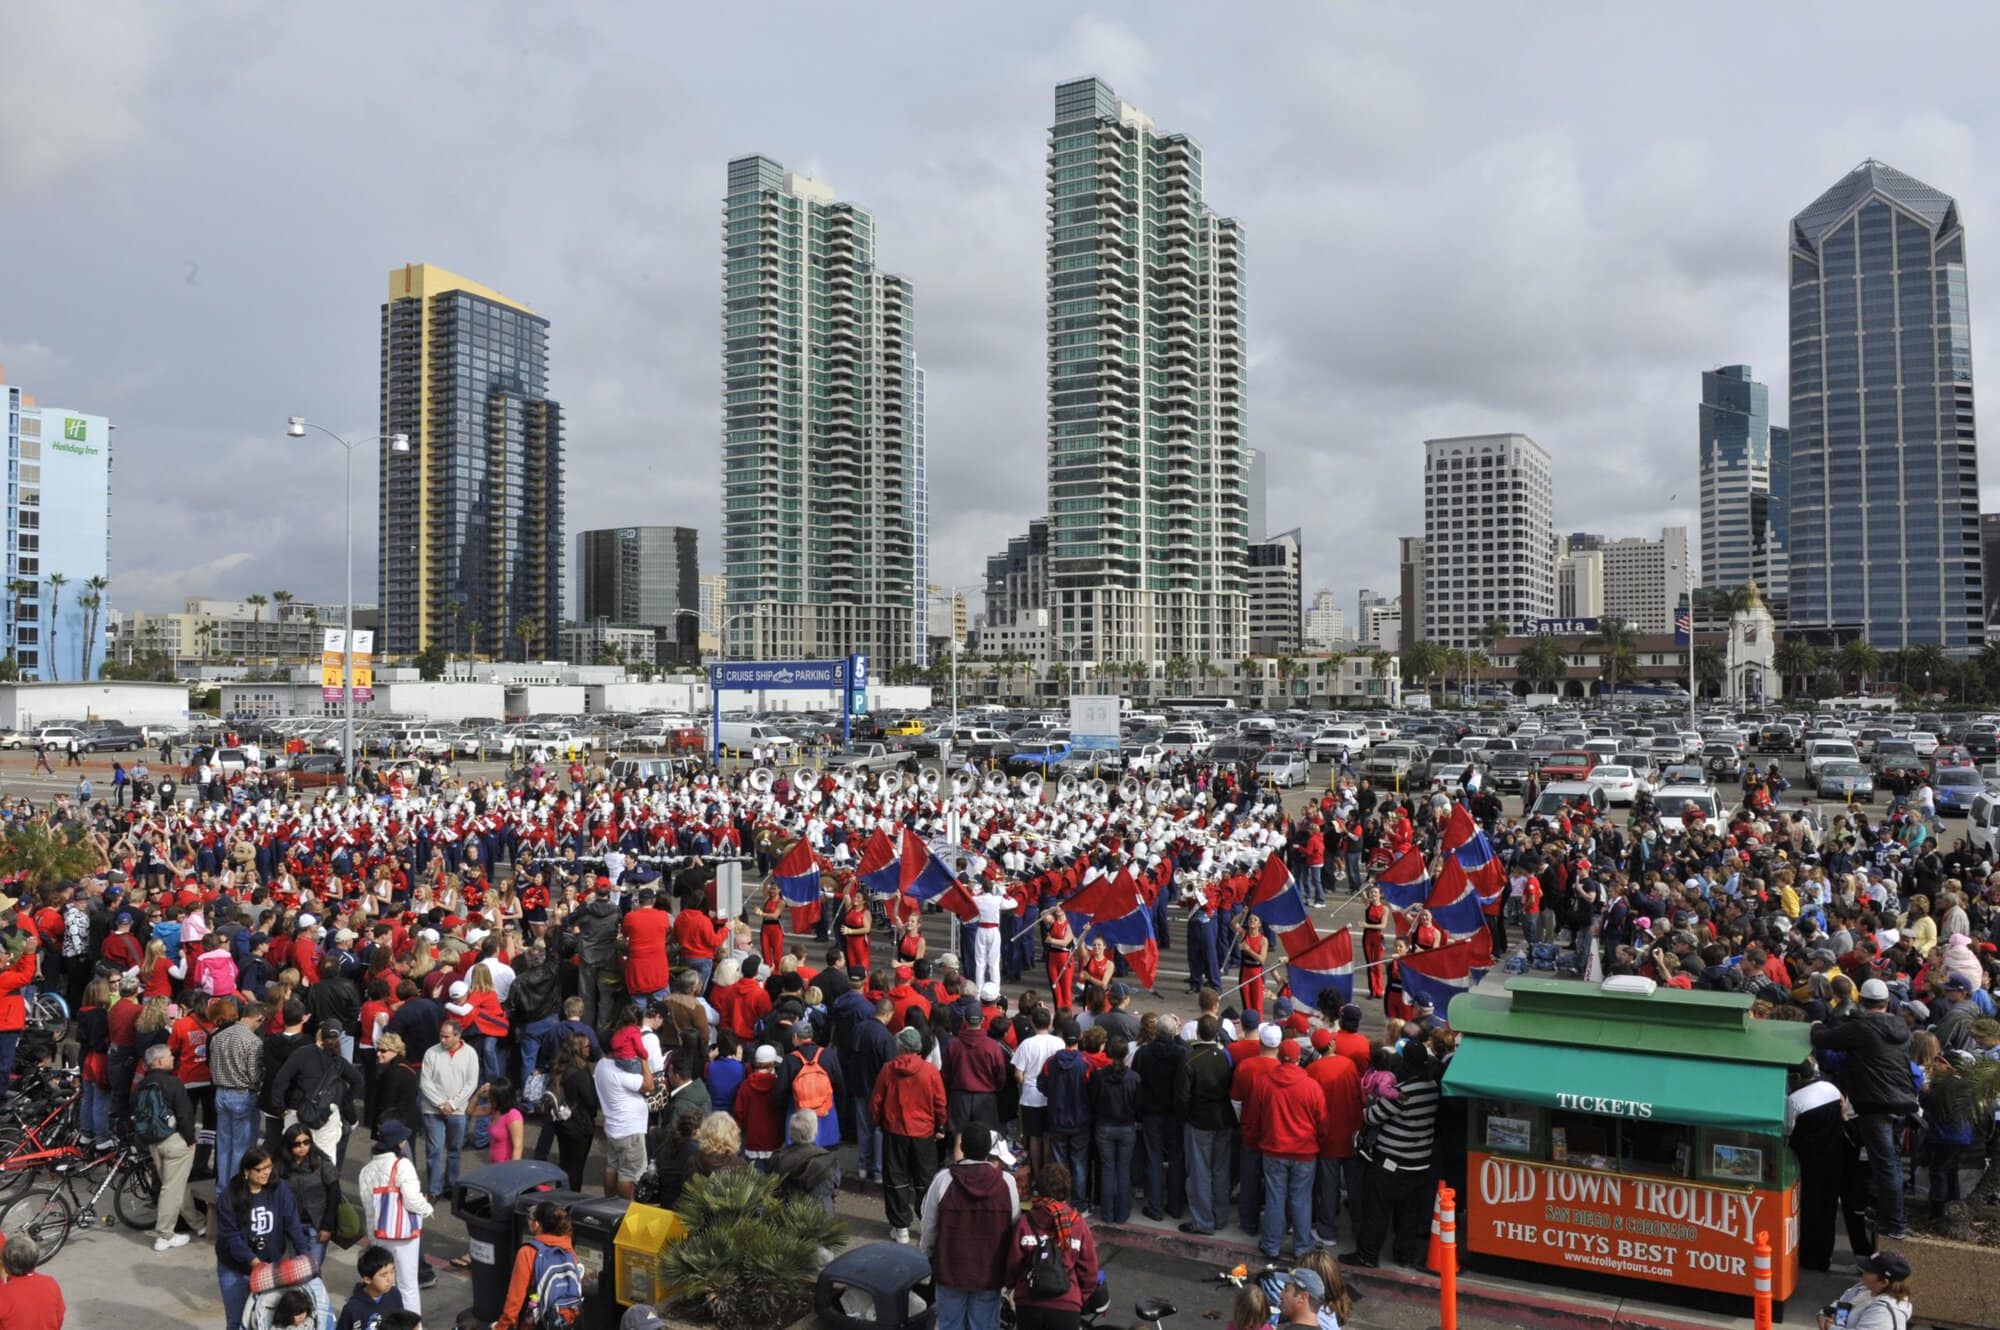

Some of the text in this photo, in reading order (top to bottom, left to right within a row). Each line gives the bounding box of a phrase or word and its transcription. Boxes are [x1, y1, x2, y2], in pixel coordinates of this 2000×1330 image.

[52, 441, 98, 455] Holiday Inn
[1526, 619, 1586, 633] Santa
[716, 667, 723, 679] 5
[727, 669, 831, 681] CRUISE SHIP PARKING
[835, 665, 842, 678] 5
[855, 656, 864, 678] 5
[856, 694, 864, 710] P
[1556, 1092, 1653, 1118] TICKETS
[1480, 1159, 1537, 1205] OLD
[1541, 1168, 1622, 1206] TOWN
[1632, 1179, 1765, 1245] TROLLEY
[251, 1206, 274, 1236] SD
[1545, 1205, 1698, 1242] SAN DIEGO & CORONADO
[1493, 1220, 1747, 1277] THE CITY'S BEST TOUR
[1564, 1252, 1673, 1277] www.trolleytours.com
